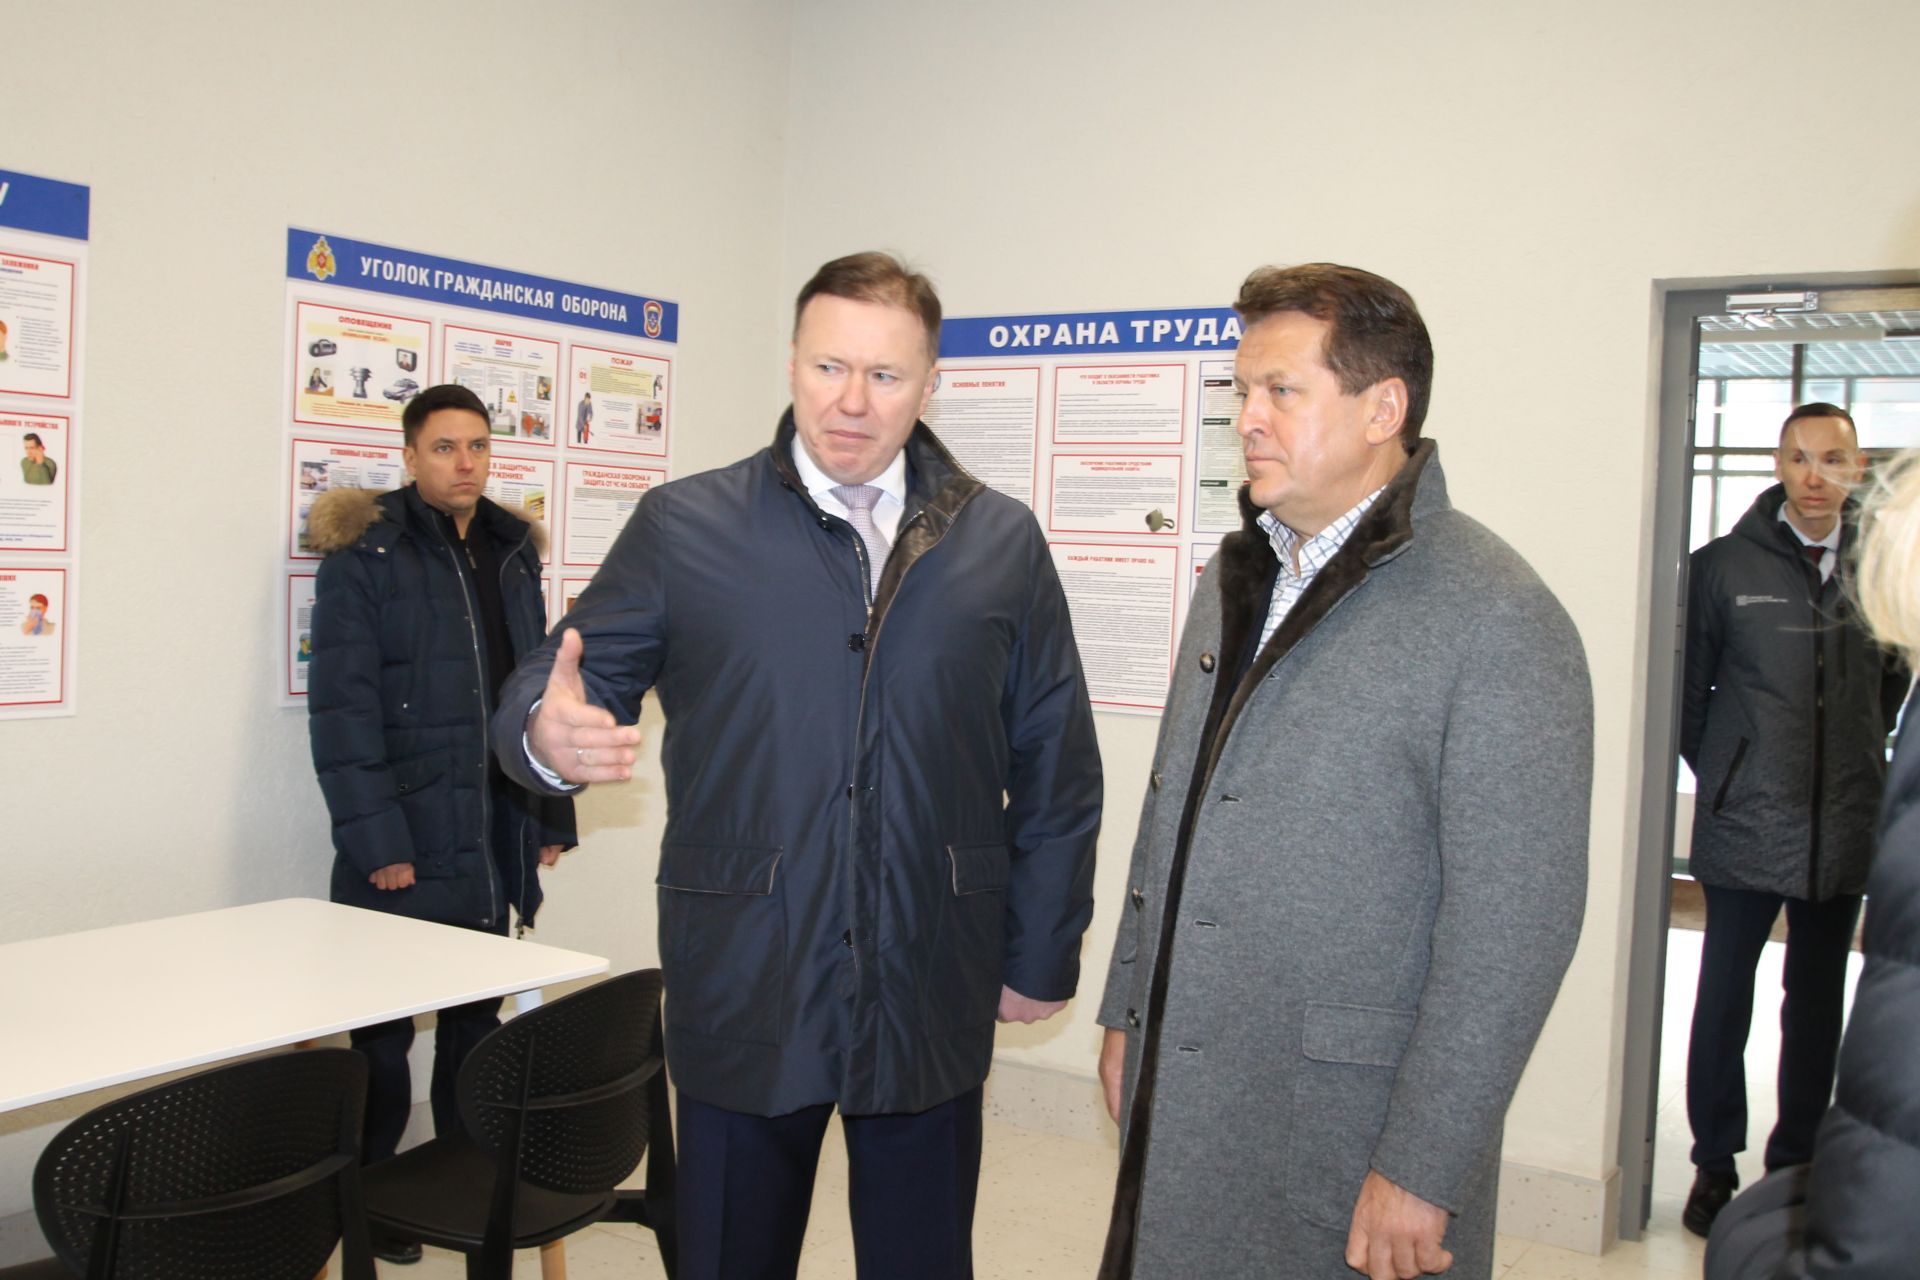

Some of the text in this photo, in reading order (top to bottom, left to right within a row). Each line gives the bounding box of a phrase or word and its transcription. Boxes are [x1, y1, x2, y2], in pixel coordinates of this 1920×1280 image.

[360, 256, 628, 323] УГОЛОК ГРАЖДАНСКАЯ ОБОРОНА
[988, 317, 1242, 348] ОХРАНА ТРУДА
